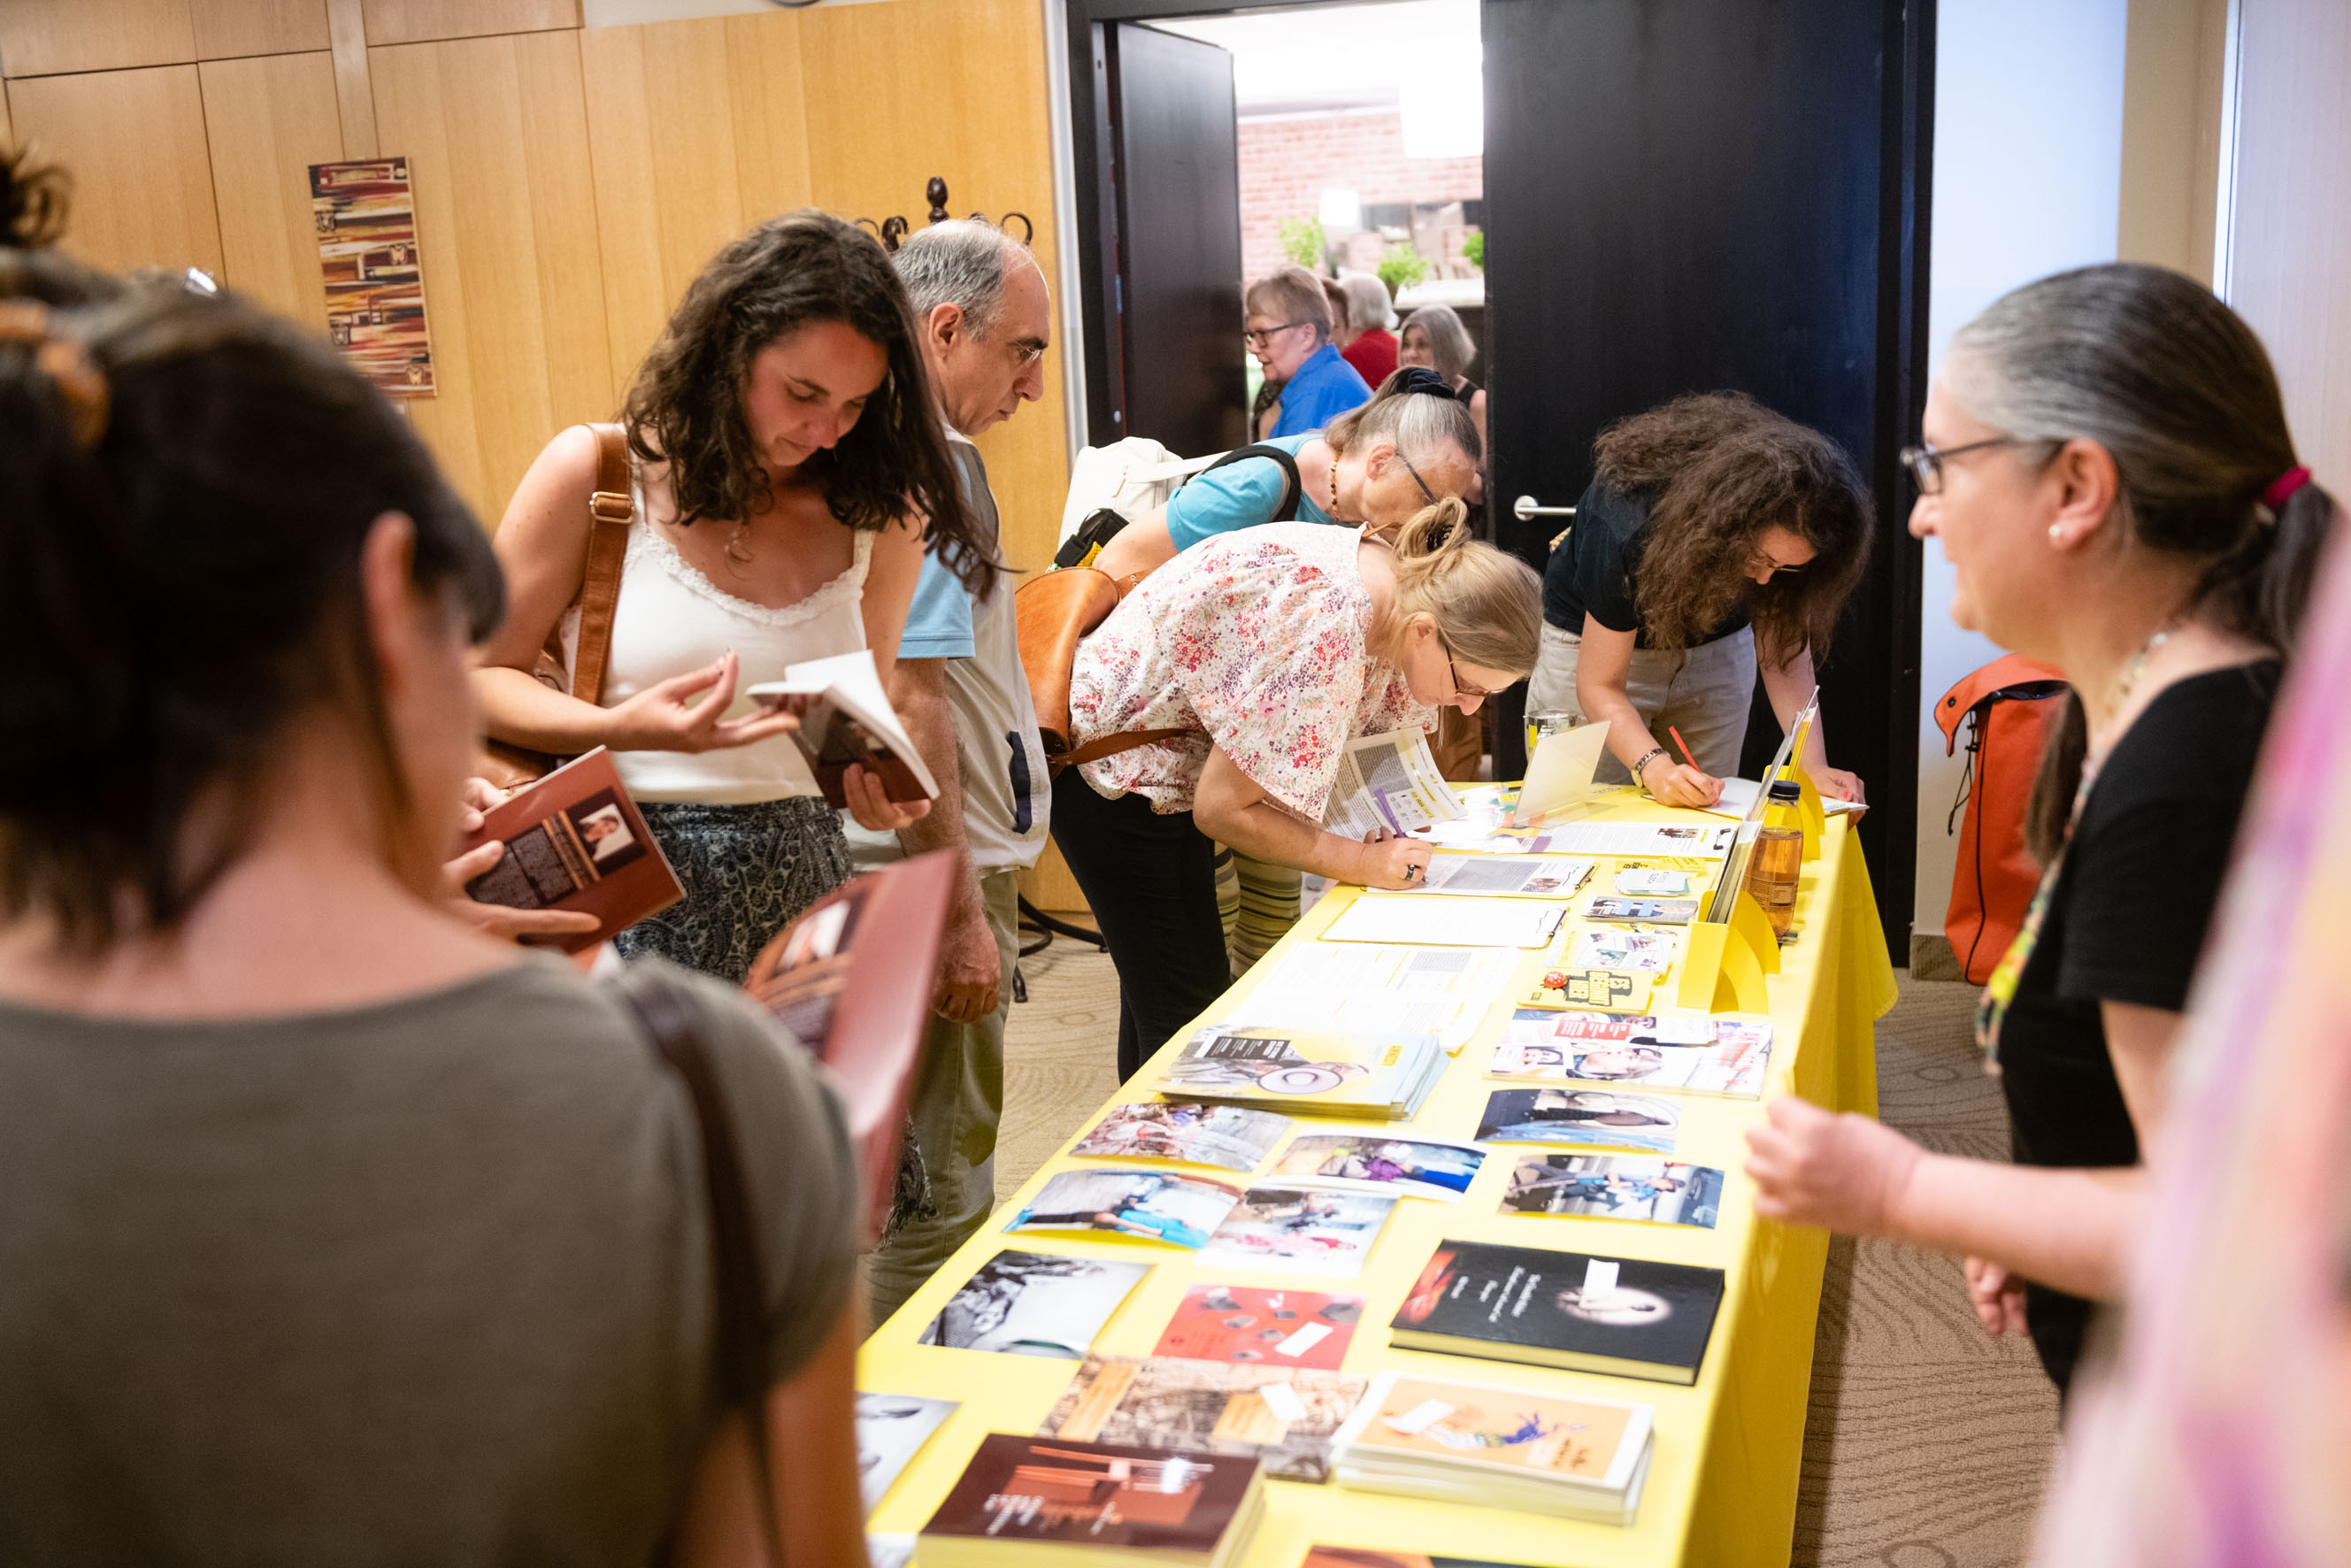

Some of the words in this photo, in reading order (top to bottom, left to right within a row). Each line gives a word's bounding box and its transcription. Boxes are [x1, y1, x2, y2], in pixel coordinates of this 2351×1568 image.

[1568, 979, 1589, 1000] HIER
[1588, 971, 1610, 1006] BEGINNT
[1610, 977, 1630, 990] ES
